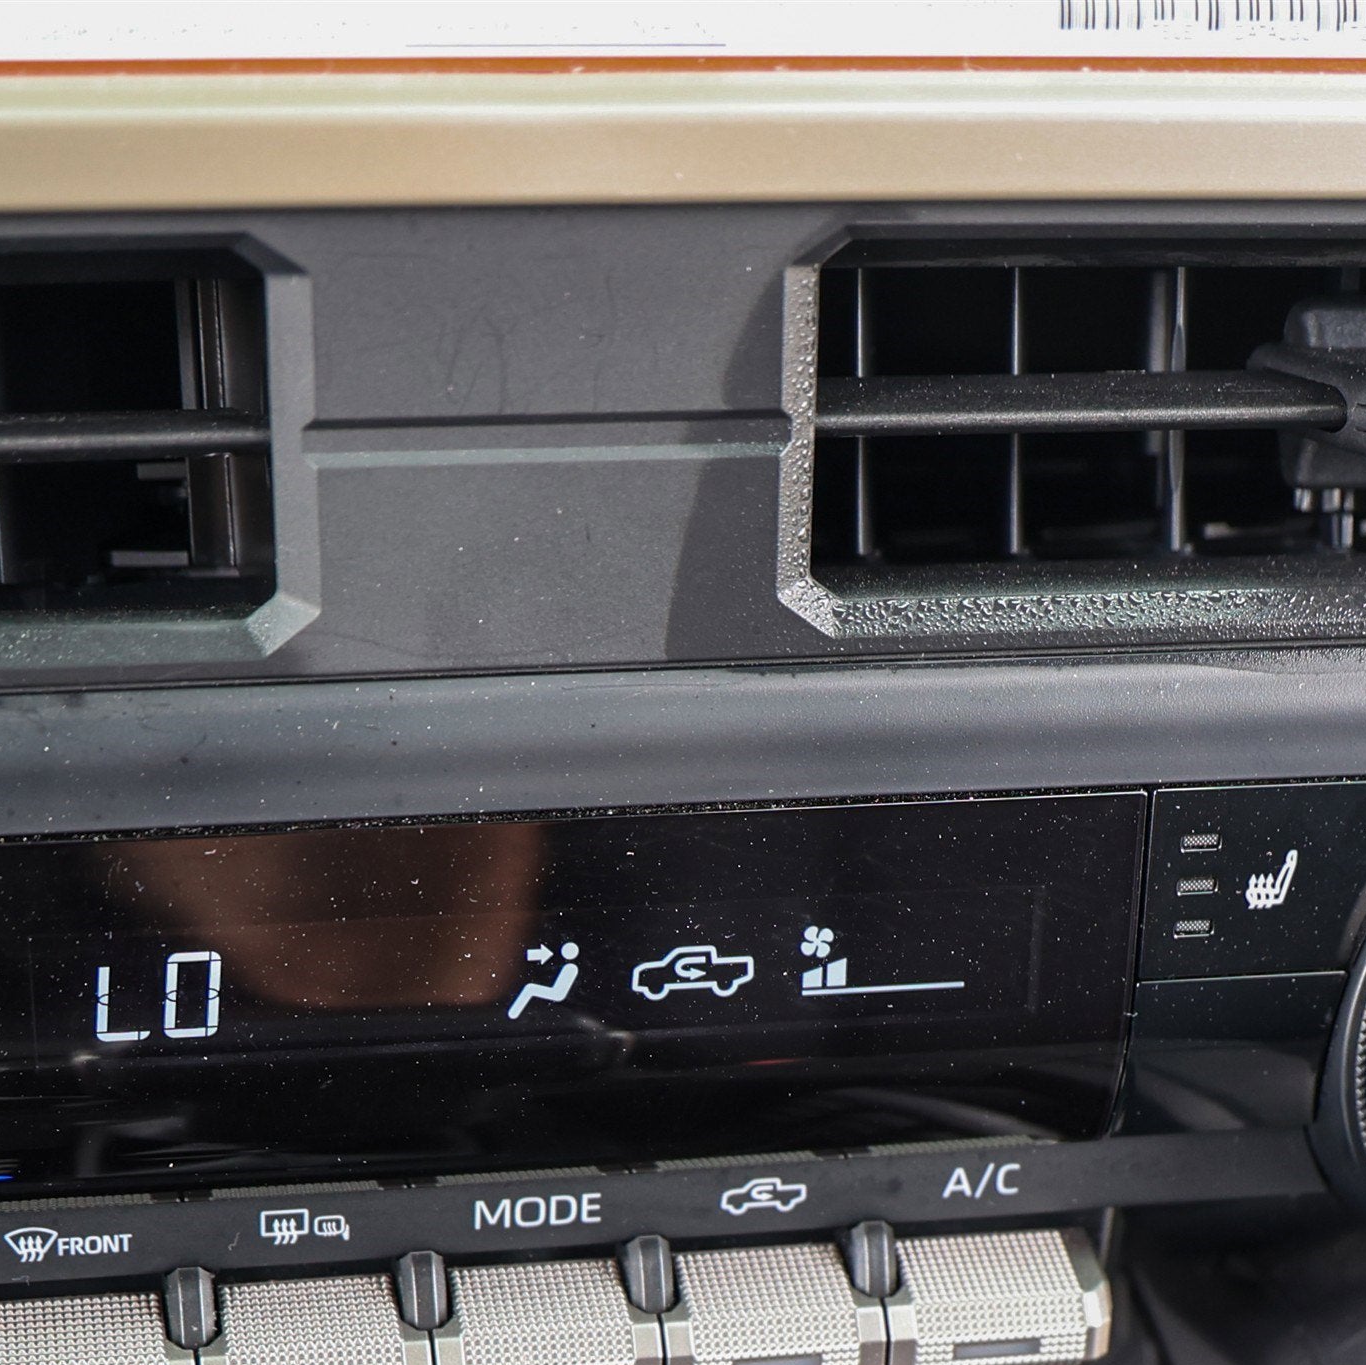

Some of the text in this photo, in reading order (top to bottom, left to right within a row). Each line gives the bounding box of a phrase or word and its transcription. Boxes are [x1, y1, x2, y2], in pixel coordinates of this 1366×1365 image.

[942, 1162, 1021, 1200] A/C
[473, 1192, 603, 1231] MODE
[56, 1232, 133, 1257] FRONT
